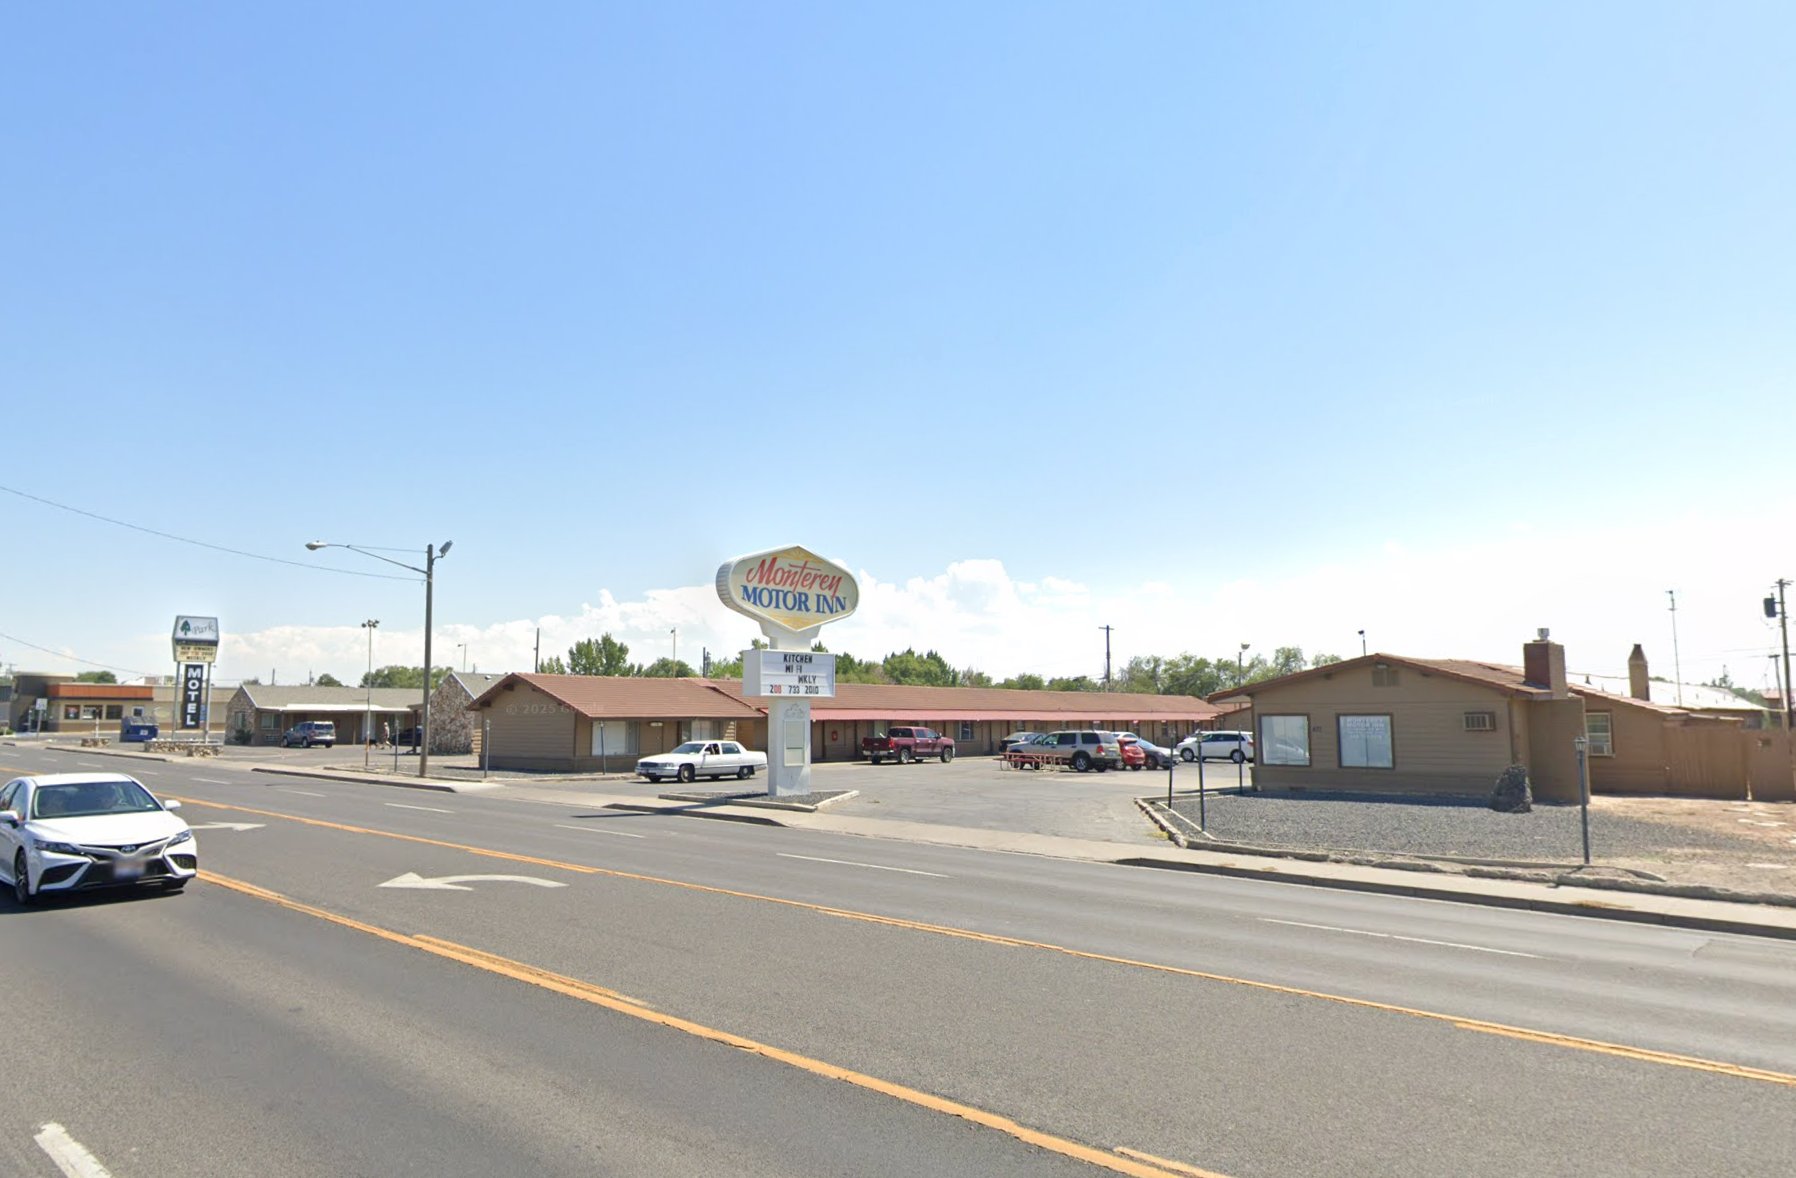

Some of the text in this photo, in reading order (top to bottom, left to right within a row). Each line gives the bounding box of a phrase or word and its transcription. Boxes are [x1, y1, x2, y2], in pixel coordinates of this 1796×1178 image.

[746, 557, 842, 597] Monterey
[740, 585, 847, 614] MOTOR INN
[783, 653, 813, 664] KITCHEN
[187, 668, 202, 726] MOTEL
